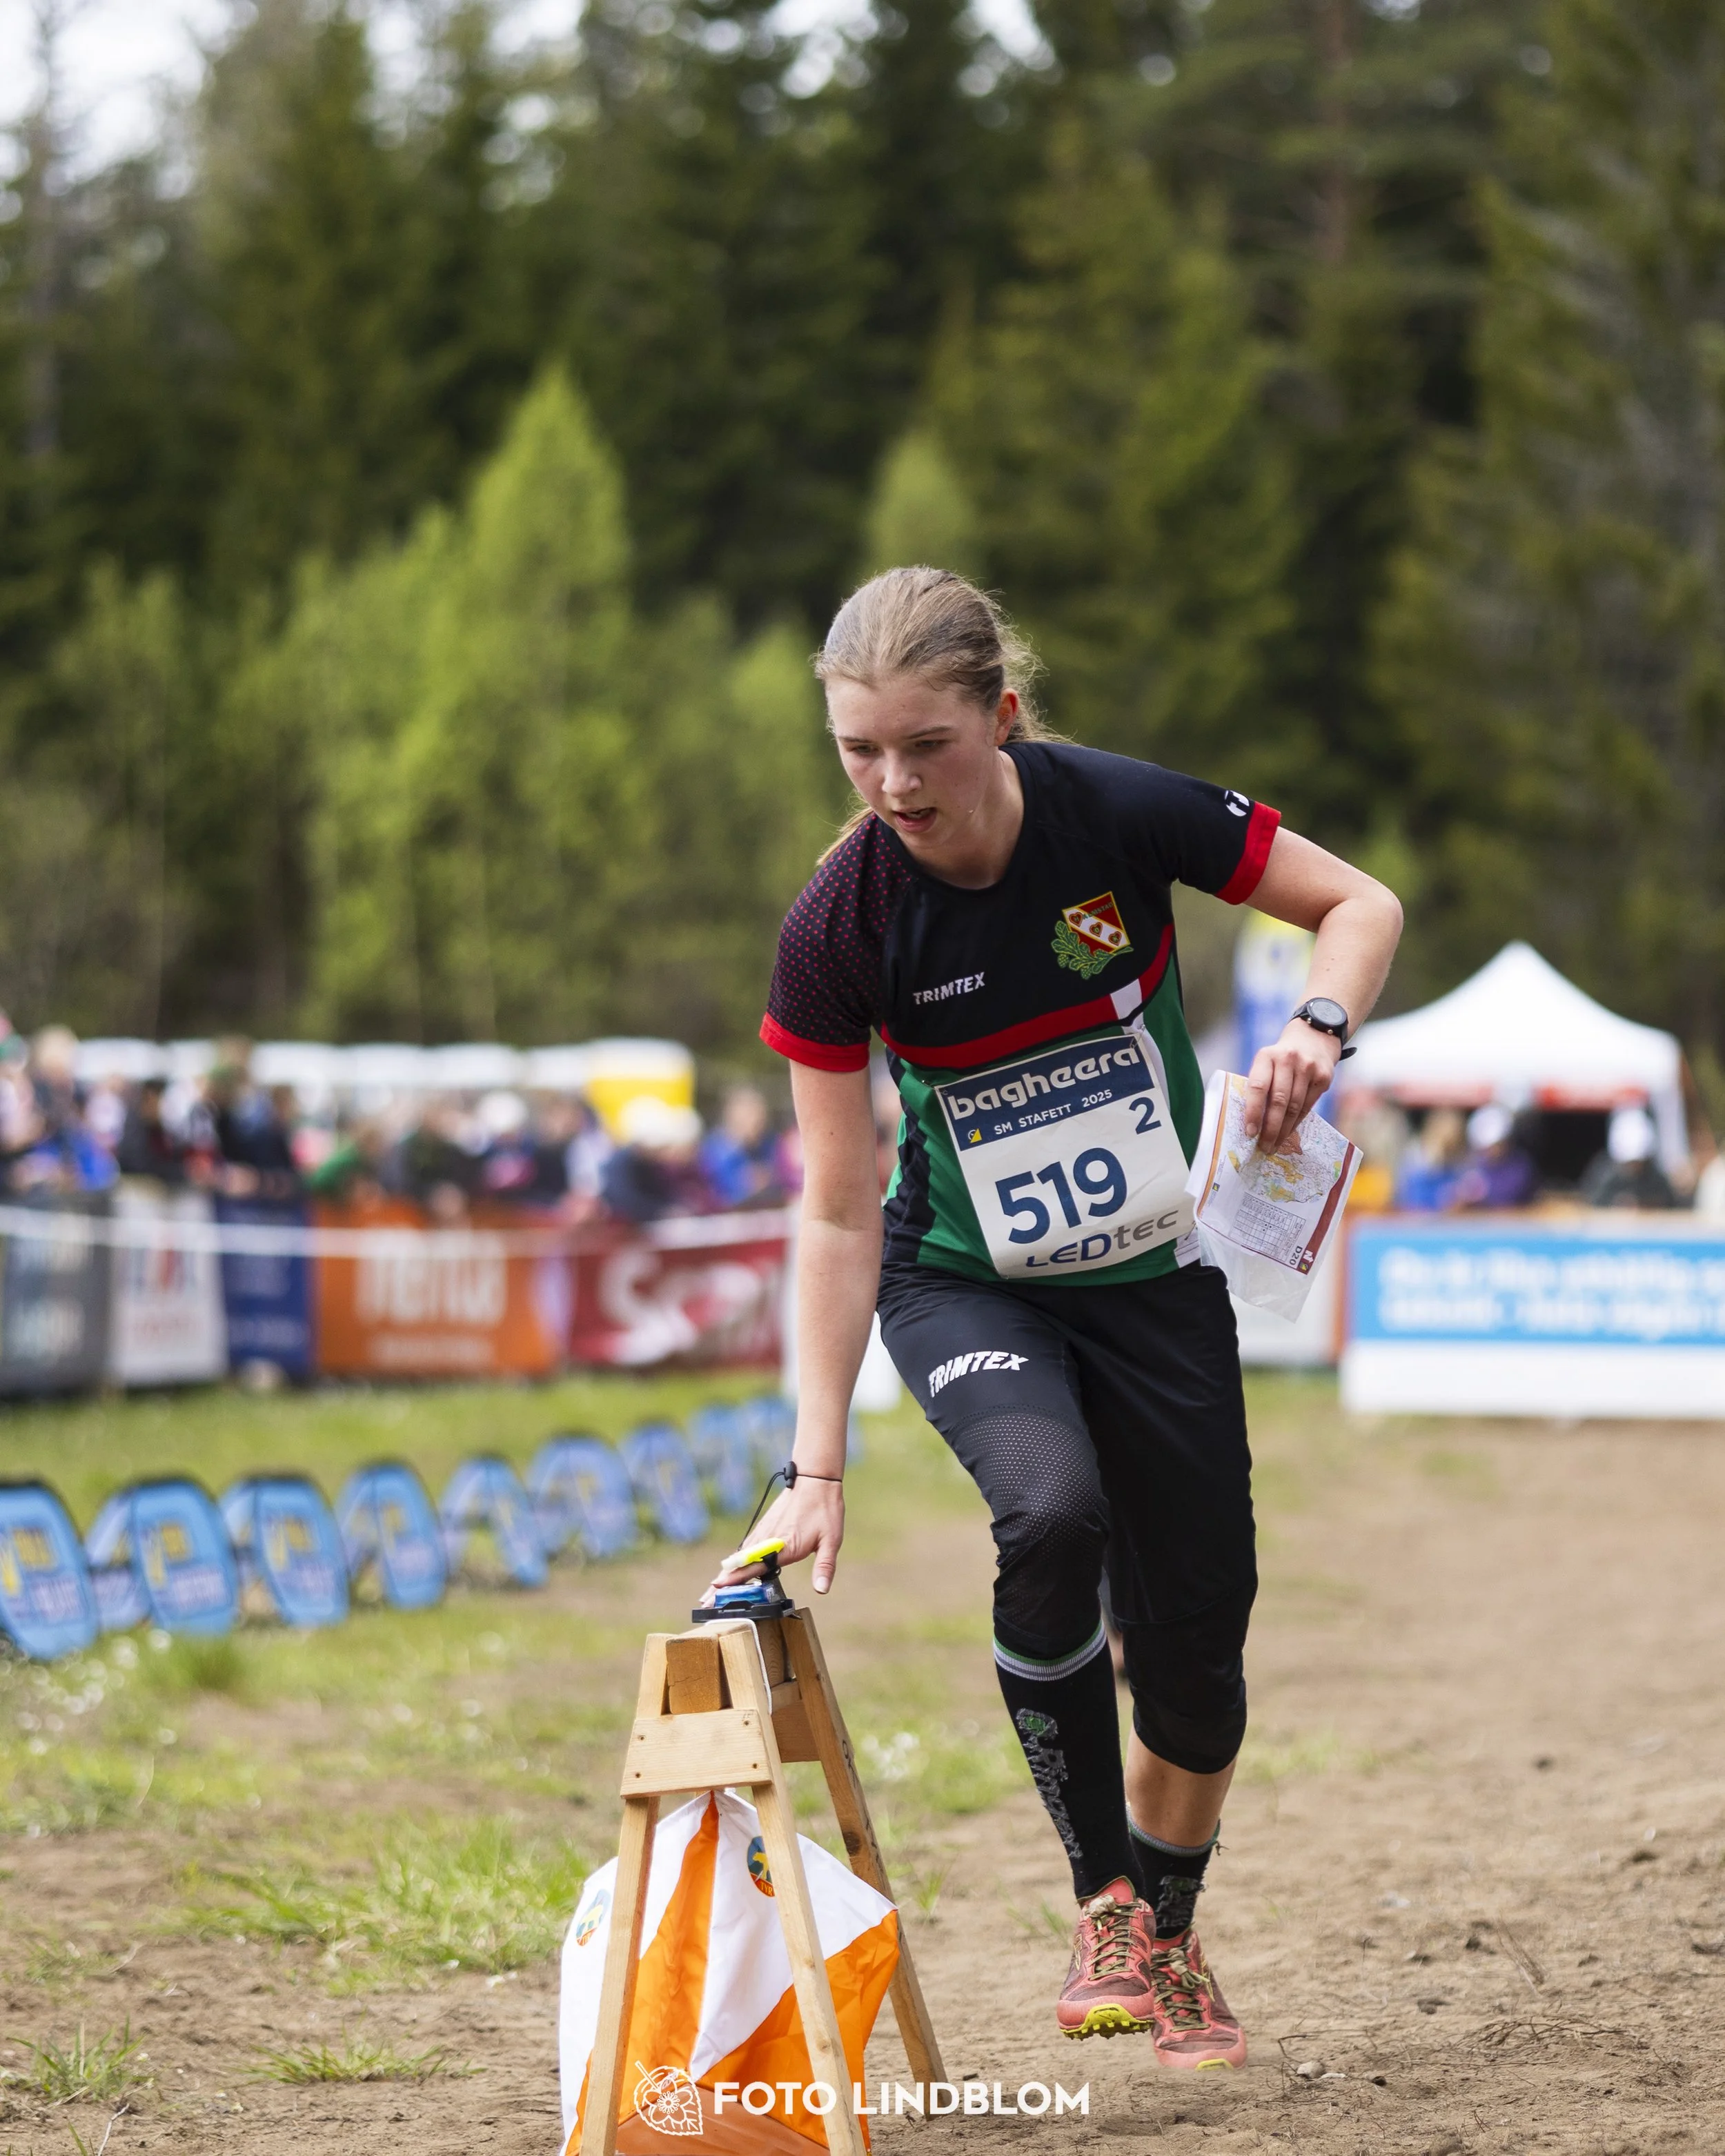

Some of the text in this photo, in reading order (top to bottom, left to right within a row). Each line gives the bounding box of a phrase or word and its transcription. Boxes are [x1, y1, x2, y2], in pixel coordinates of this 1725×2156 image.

[913, 971, 985, 1005] TRIMTEX
[947, 1048, 1140, 1120] bagheera
[994, 1089, 1113, 1135] SM STAFETT 2025
[1129, 1096, 1162, 1135] 2
[995, 1147, 1127, 1244] 519
[1289, 1245, 1303, 1265] D20
[928, 1351, 1029, 1398] TRIMTEX
